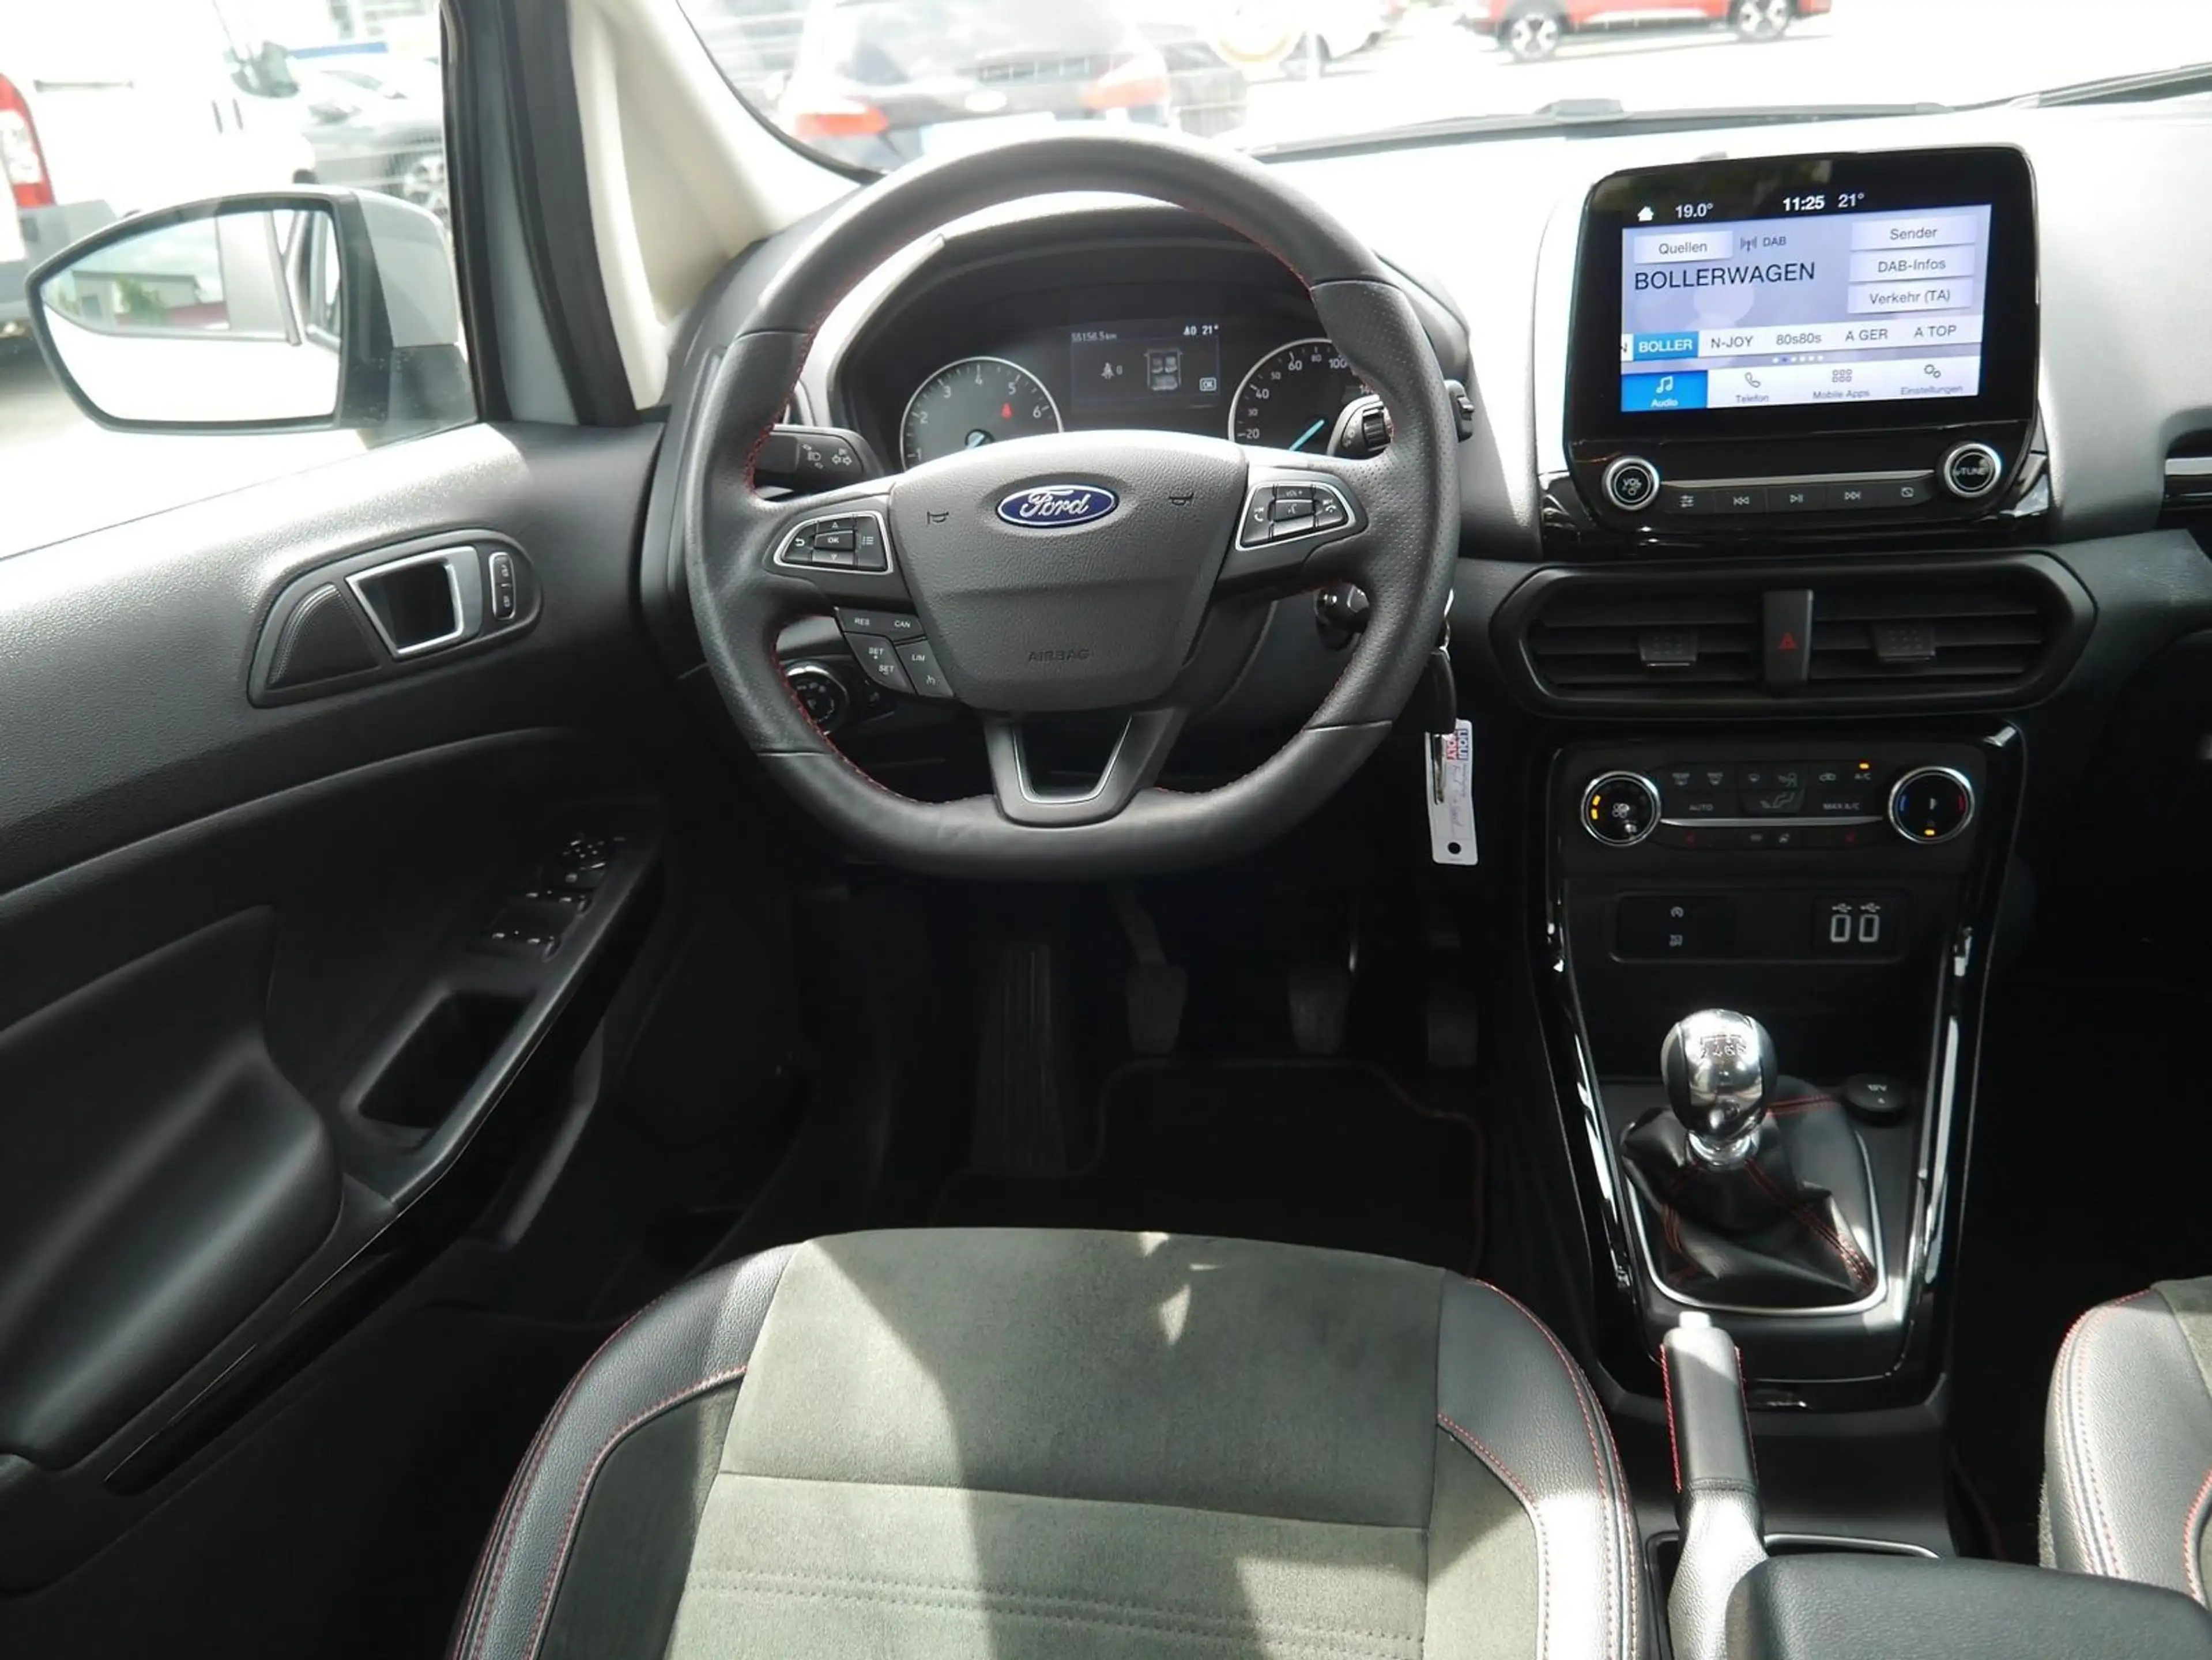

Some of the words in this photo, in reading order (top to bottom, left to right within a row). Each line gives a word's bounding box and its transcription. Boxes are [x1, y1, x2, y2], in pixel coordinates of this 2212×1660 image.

[1783, 195, 1825, 212] 11:25
[1838, 193, 1865, 208] 21°
[1675, 203, 1713, 218] 19.0°
[1890, 228, 1938, 240] Sender
[1762, 236, 1787, 247] DAB
[1659, 242, 1708, 255] Quellen
[1877, 259, 1946, 273] DAB-Infos
[1634, 262, 1815, 290] BOLLERWAGEN
[1870, 292, 1920, 305] Verkehr
[1924, 289, 1951, 303] (TA)
[1845, 330, 1855, 342] A
[1859, 328, 1889, 341] GER
[1914, 326, 1924, 338] A
[1929, 324, 1957, 338] TOP
[1638, 338, 1693, 354] BOLLER
[1711, 335, 1754, 349] N-JOY
[1776, 333, 1822, 345] 80s80s
[1288, 360, 1302, 371] 60
[1328, 357, 1347, 369] 100
[975, 375, 983, 386] 4
[943, 385, 952, 398] 3
[1007, 383, 1017, 395] 5
[1256, 388, 1269, 399] 40
[1812, 390, 1843, 400] Mobile
[1846, 389, 1870, 399] Apps
[1900, 386, 1964, 395] Einstellungen
[1650, 398, 1679, 408] Audio
[1736, 394, 1769, 403] Telefon
[920, 411, 928, 425] 2
[1032, 407, 1042, 418] 6
[1246, 428, 1260, 439] 20
[1622, 477, 1642, 488] VOL
[1019, 489, 1092, 518] Ford
[854, 617, 870, 626] RES
[894, 620, 911, 628] CAN
[1028, 648, 1090, 662] AIRBAG
[879, 665, 895, 673] SET
[1689, 802, 1713, 812] AUTO
